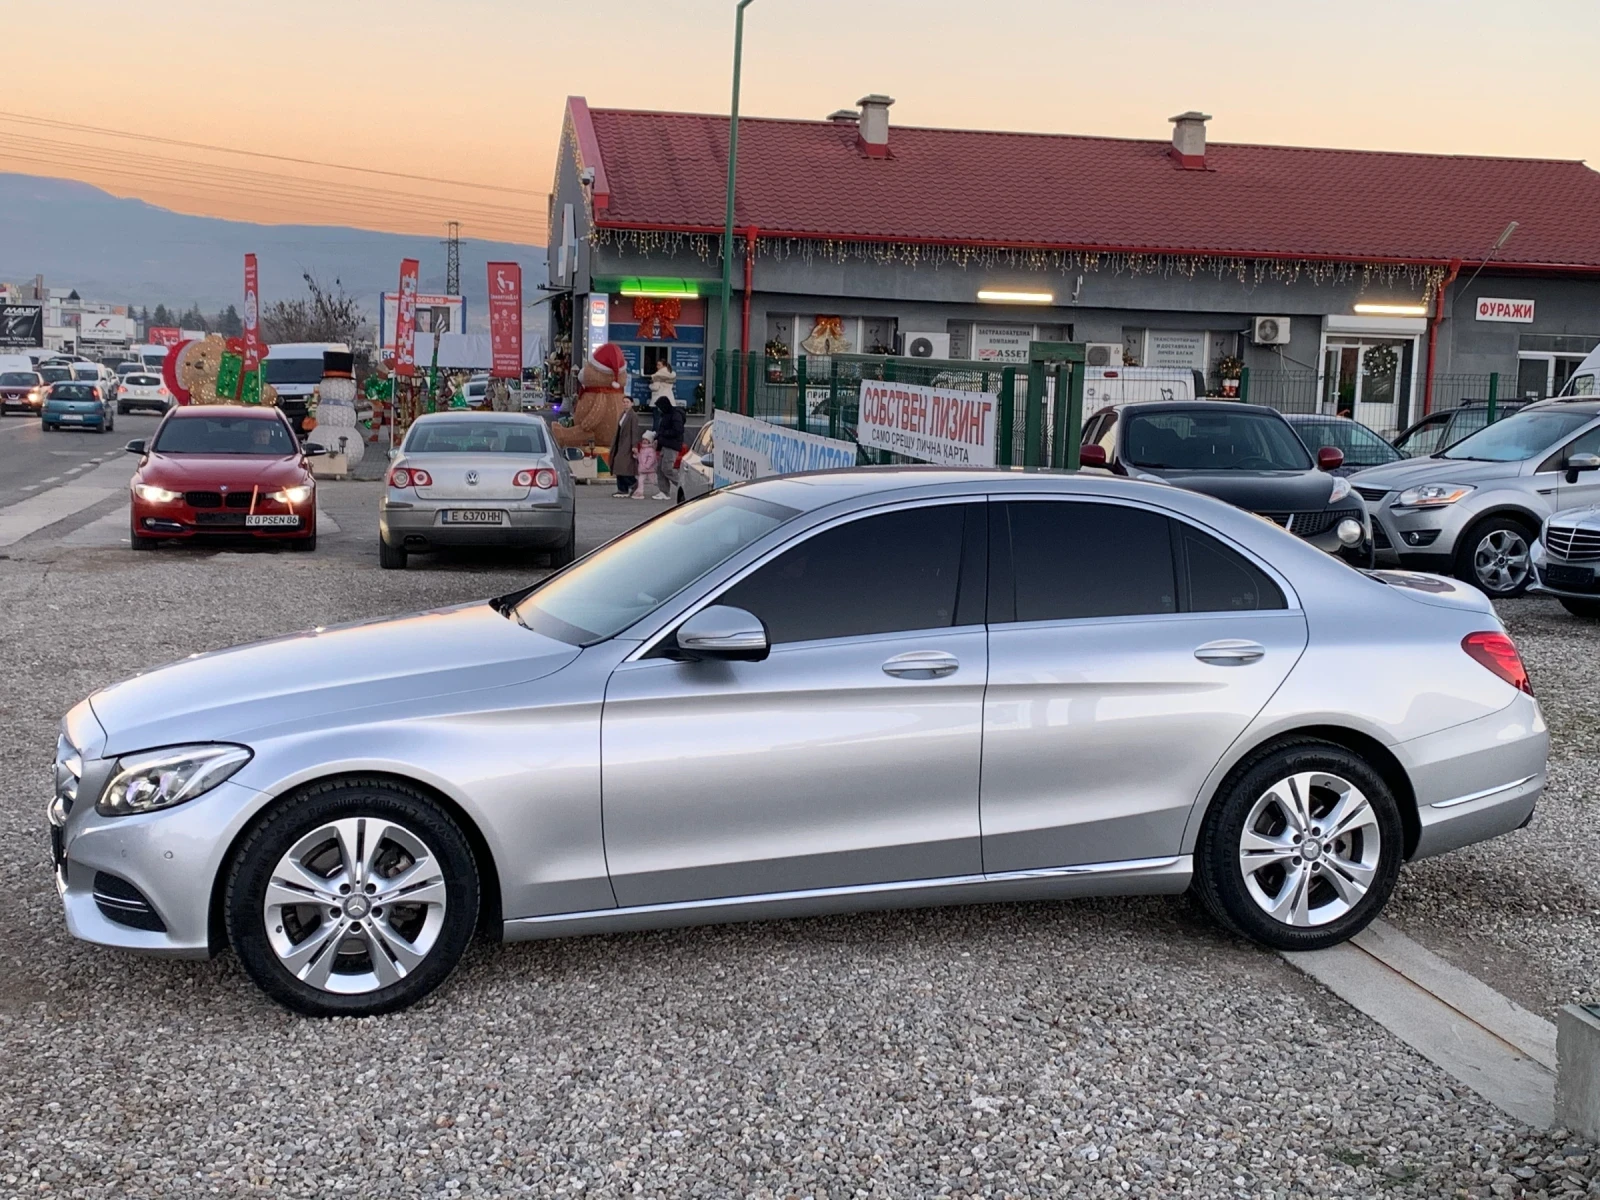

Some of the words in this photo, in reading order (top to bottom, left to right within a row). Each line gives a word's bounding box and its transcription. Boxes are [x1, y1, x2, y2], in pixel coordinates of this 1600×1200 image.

[1479, 302, 1532, 319] ФУРАЖИ
[978, 329, 1031, 337] ЗАСТРАХОВАТЕЛНА
[997, 350, 1028, 358] ASSET
[863, 386, 928, 436] СОБСТВЕН
[929, 396, 992, 447] ЛИЗИНГ
[871, 428, 890, 444] САМО
[891, 432, 915, 451] СРЕЩУ
[916, 438, 941, 457] ЛИЧНА
[943, 445, 969, 463] КАРТА
